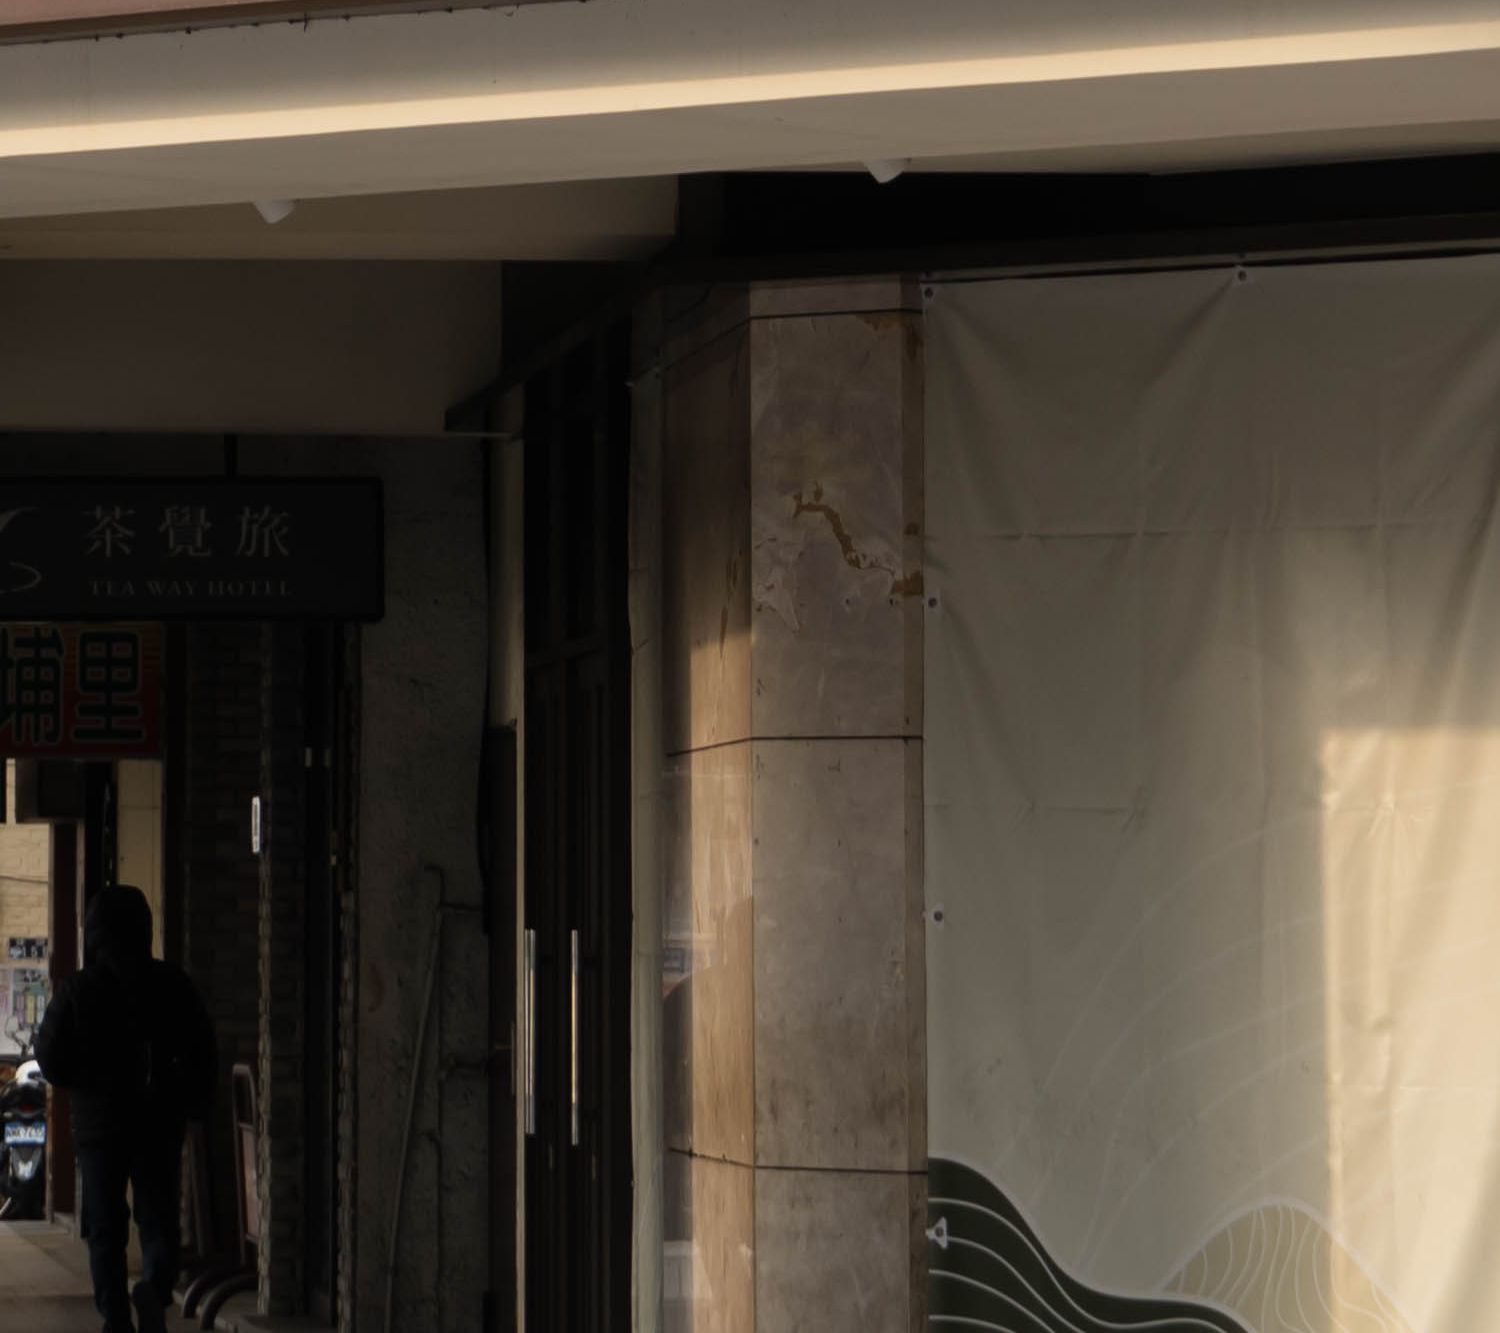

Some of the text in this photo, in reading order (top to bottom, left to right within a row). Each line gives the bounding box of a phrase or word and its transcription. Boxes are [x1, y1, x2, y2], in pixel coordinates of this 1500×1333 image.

[80, 505, 291, 557] 茶覺旅
[89, 581, 291, 597] TEA WAY HOTEL
